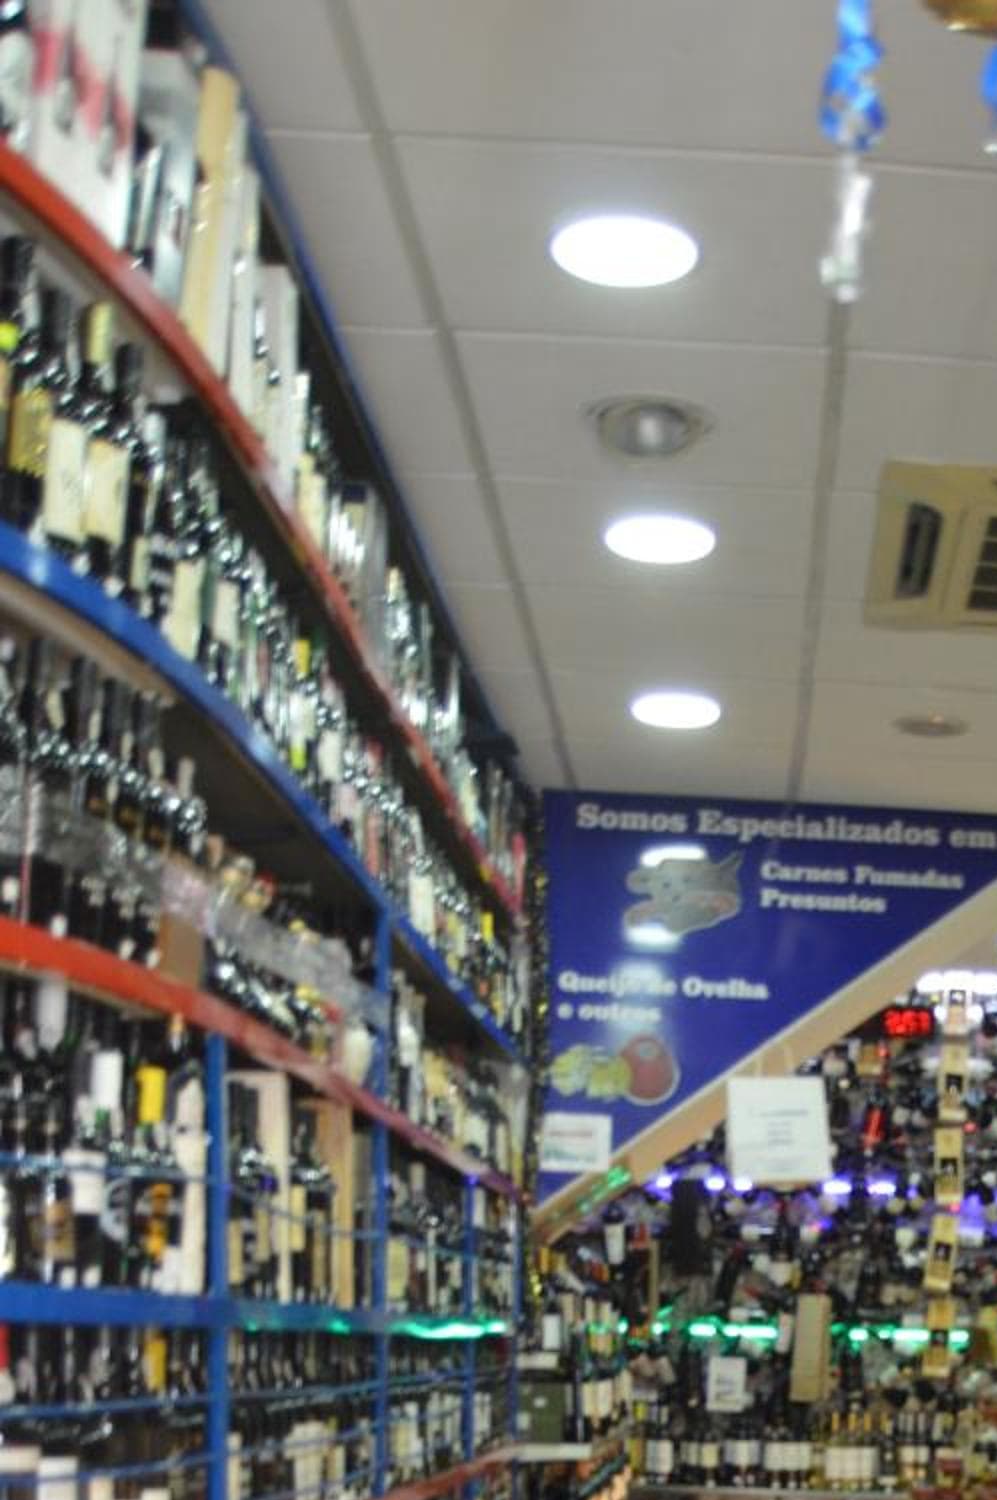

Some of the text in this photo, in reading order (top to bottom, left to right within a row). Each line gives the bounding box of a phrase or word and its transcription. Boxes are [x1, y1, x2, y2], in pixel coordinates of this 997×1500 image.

[576, 803, 687, 833] Somos
[697, 809, 940, 846] Especializados
[760, 861, 965, 890] Carnes Fumadas
[760, 888, 887, 913] Presuntos
[682, 976, 769, 1000] Ovelha
